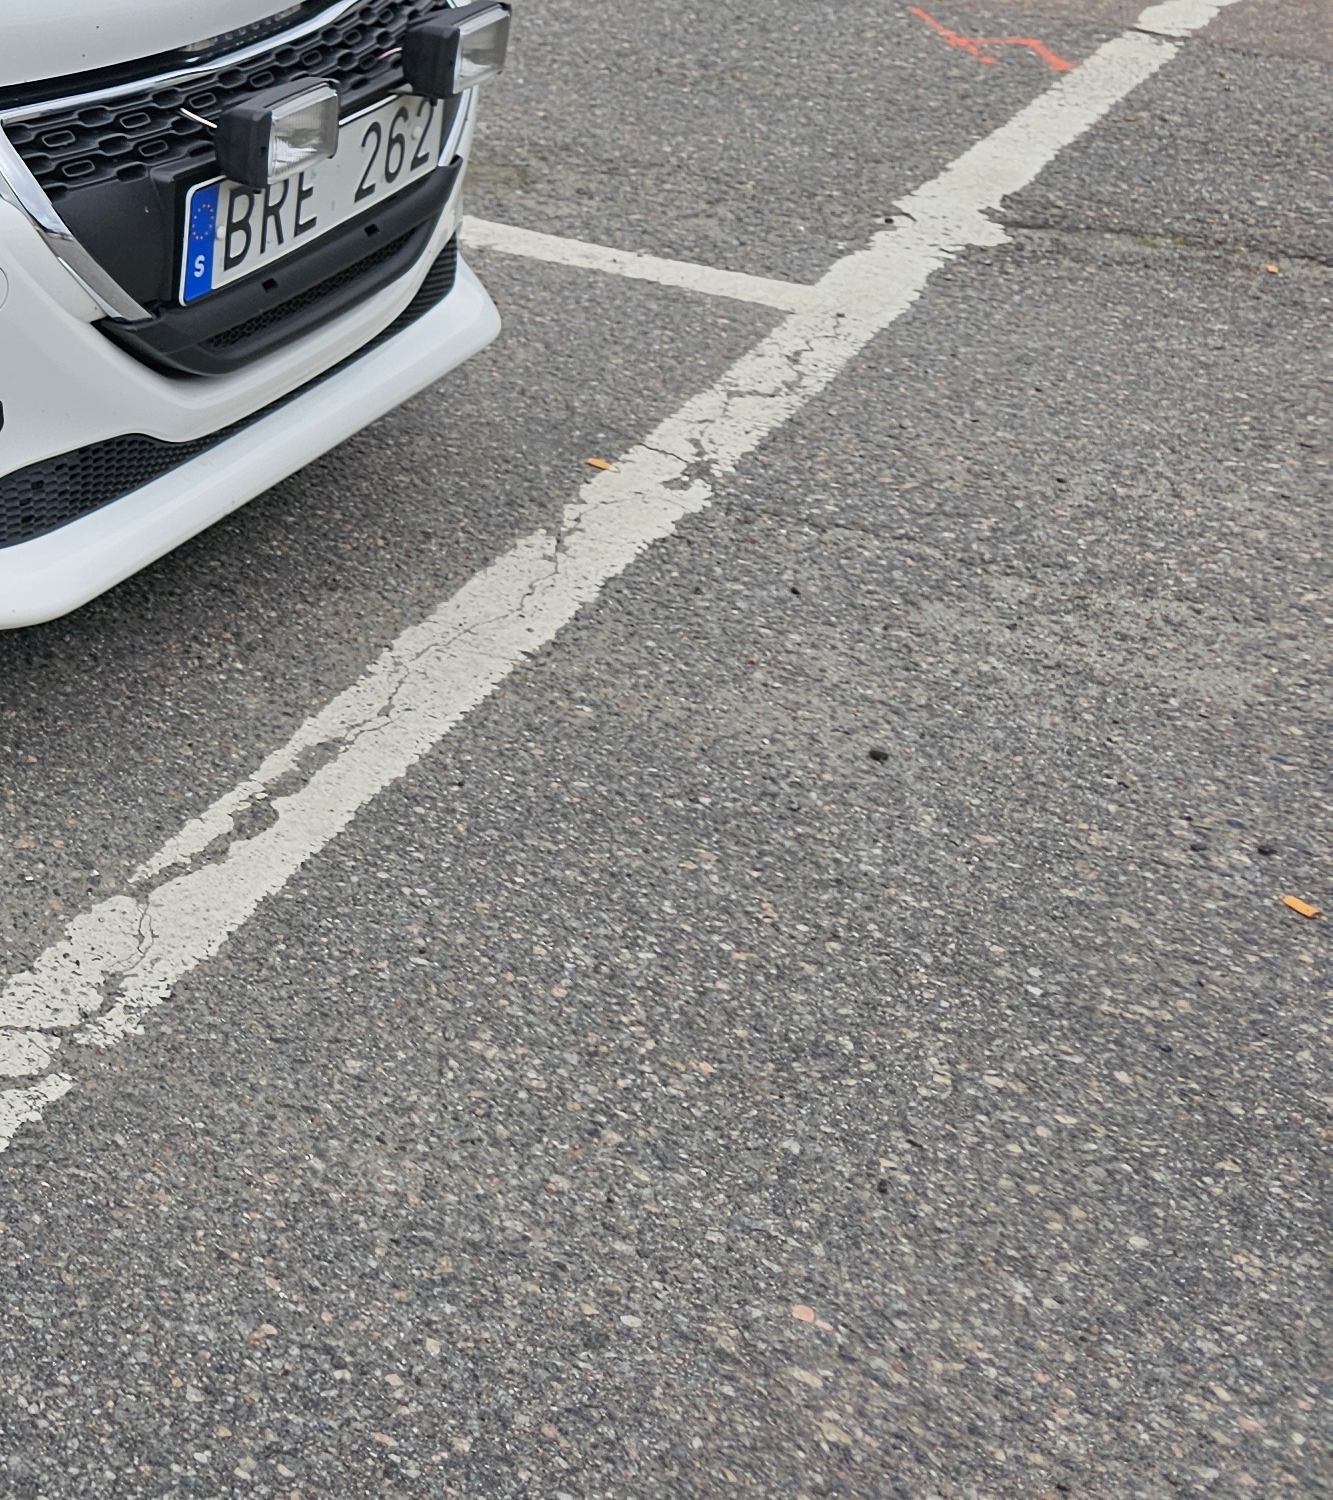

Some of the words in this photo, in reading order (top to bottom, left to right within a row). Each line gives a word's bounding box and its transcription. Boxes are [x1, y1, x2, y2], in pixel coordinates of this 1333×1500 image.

[224, 172, 317, 271] BRE
[354, 98, 434, 203] 262
[194, 254, 205, 278] S
